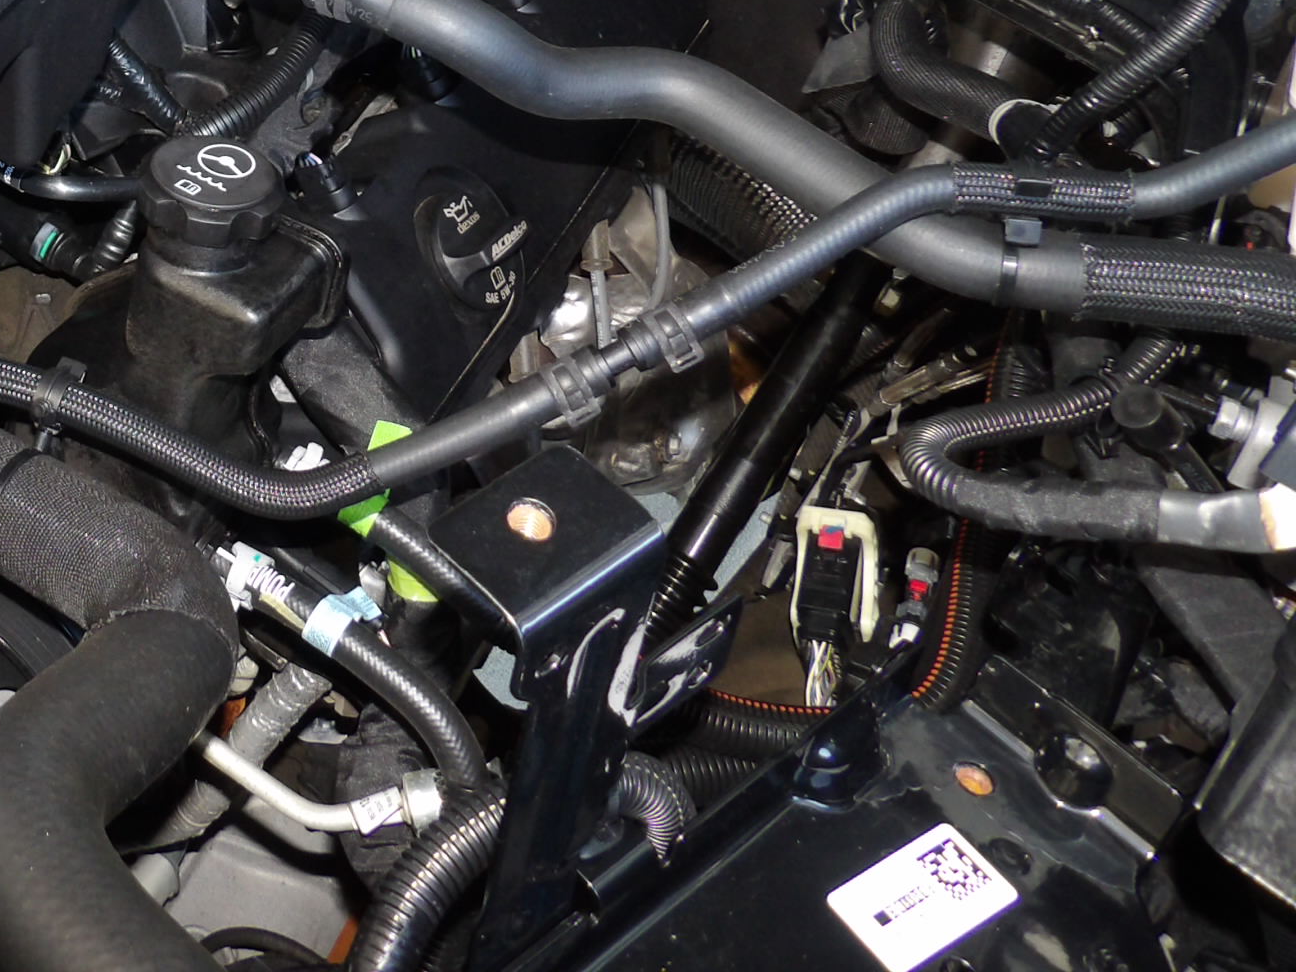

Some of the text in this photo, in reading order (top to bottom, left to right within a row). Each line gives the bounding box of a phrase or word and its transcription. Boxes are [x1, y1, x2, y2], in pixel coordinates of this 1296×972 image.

[457, 211, 480, 235] dexos
[491, 220, 527, 260] ACDelco
[485, 270, 516, 304] SAE 5W-30
